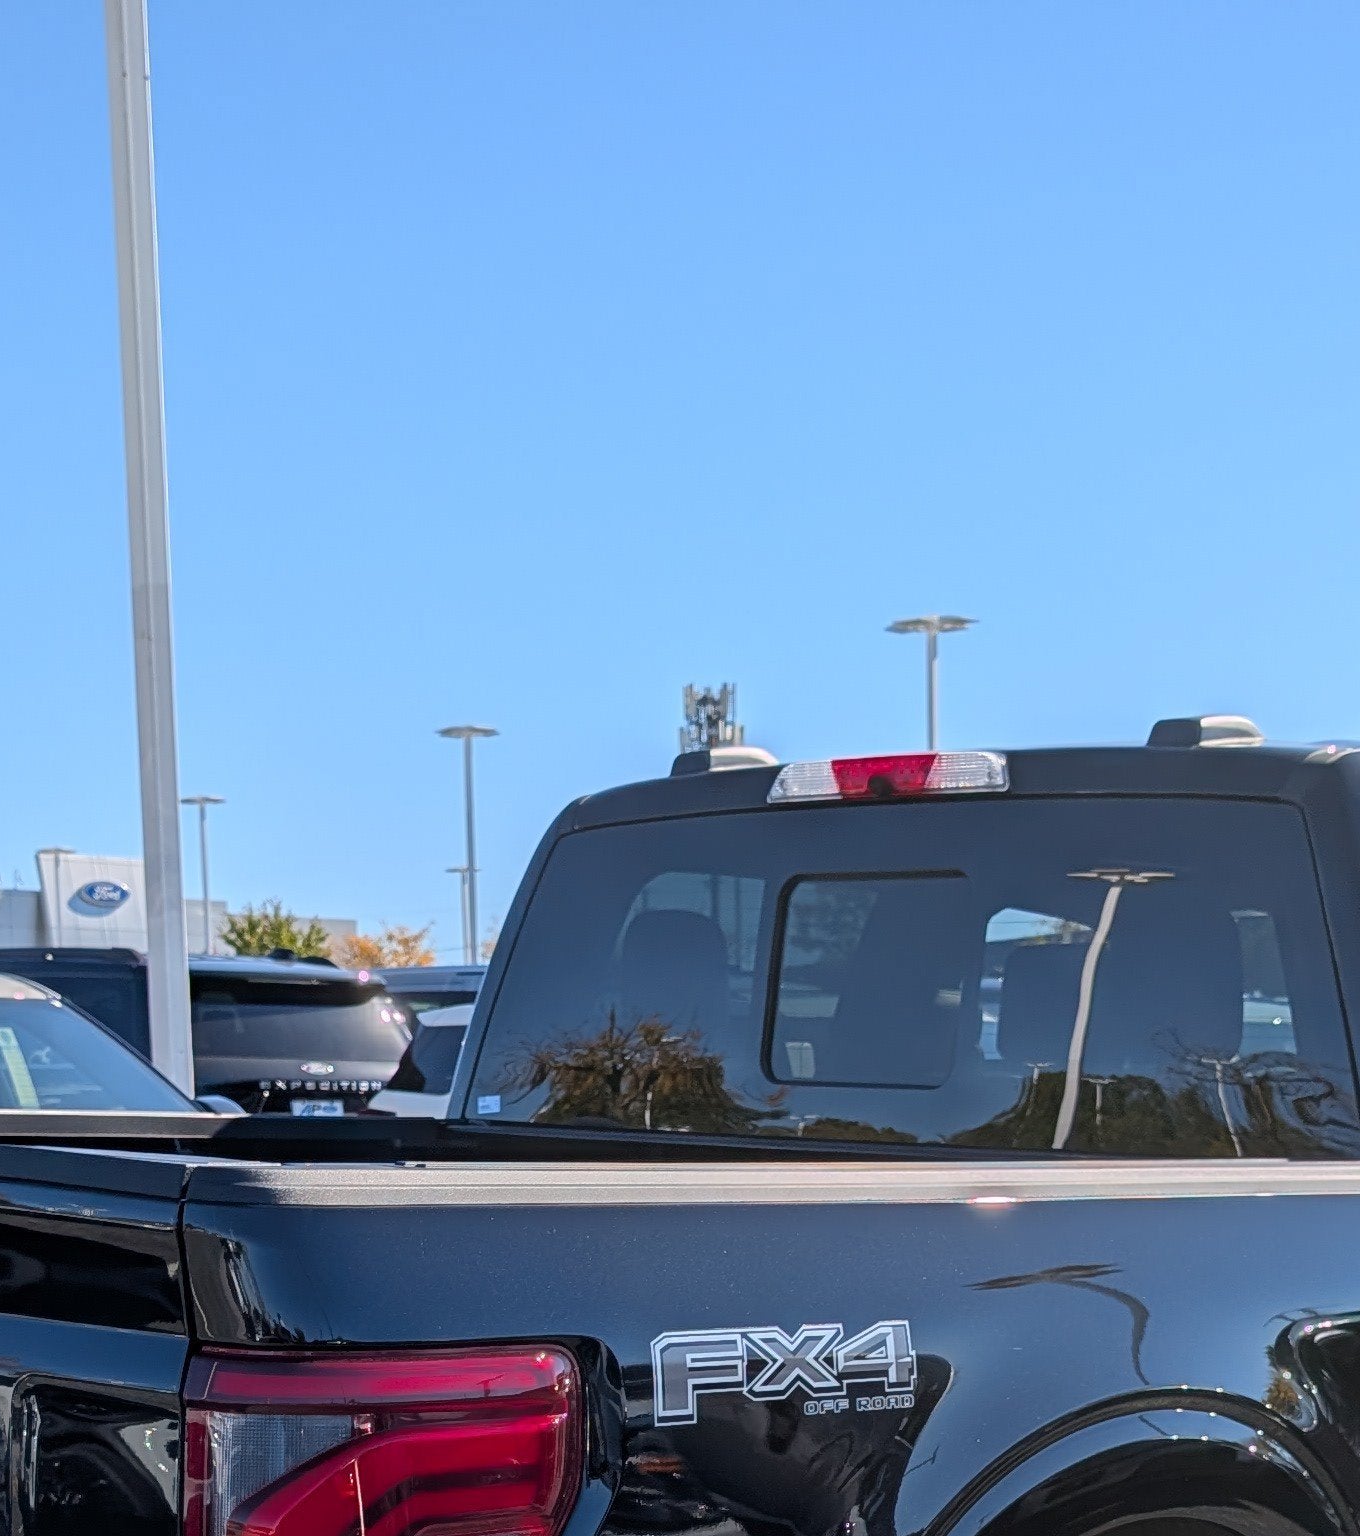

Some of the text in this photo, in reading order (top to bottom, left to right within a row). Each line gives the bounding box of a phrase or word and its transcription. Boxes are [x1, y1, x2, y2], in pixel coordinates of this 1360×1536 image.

[650, 1319, 916, 1427] FX4
[803, 1393, 916, 1416] OFF ROAD
